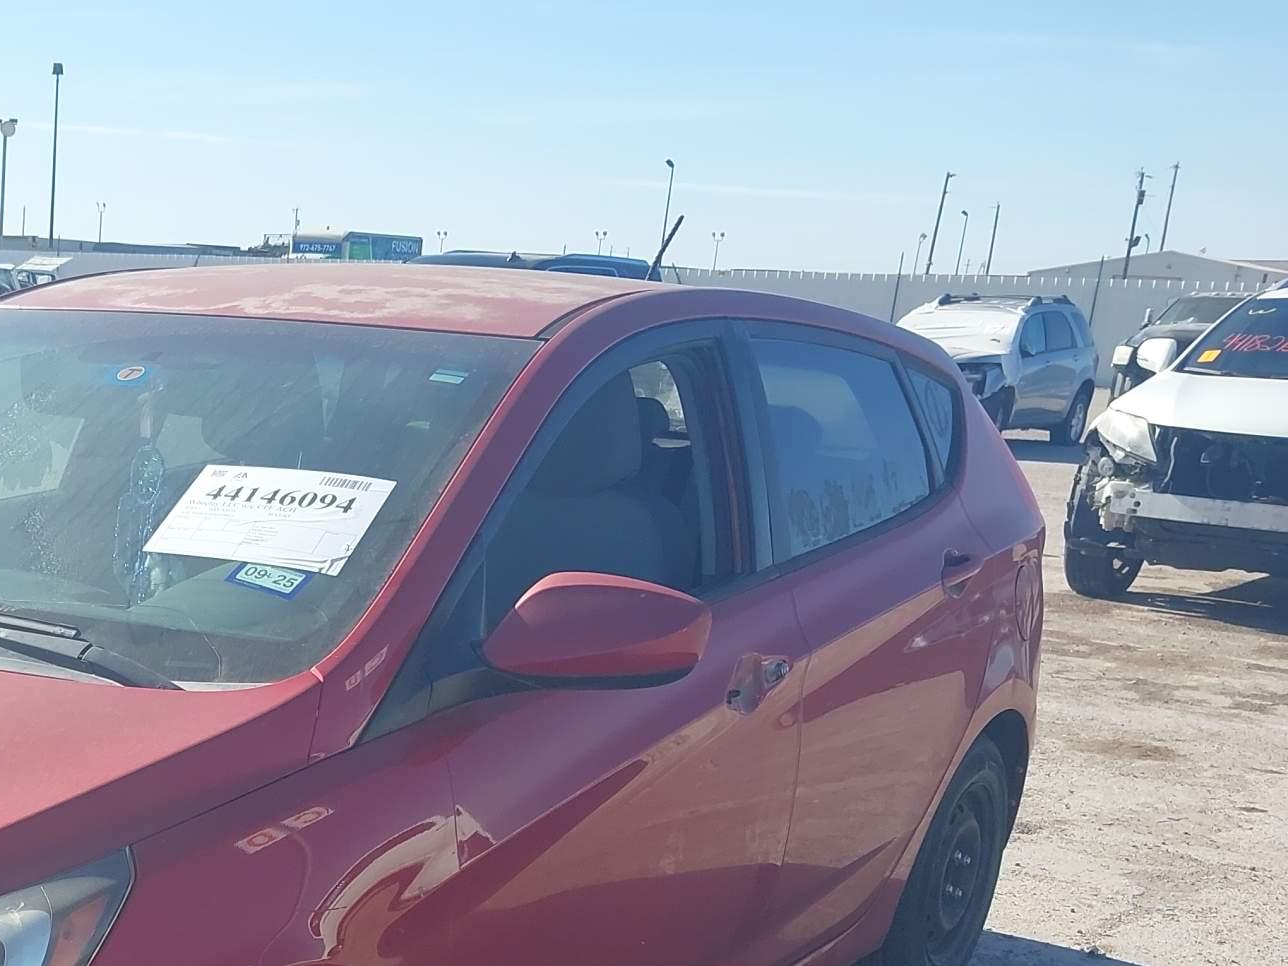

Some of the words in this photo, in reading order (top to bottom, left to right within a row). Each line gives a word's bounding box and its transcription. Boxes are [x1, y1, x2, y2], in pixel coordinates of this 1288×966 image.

[391, 240, 419, 254] FUSION
[205, 484, 357, 514] 44146094
[244, 566, 268, 580] 09
[273, 574, 298, 588] 25
